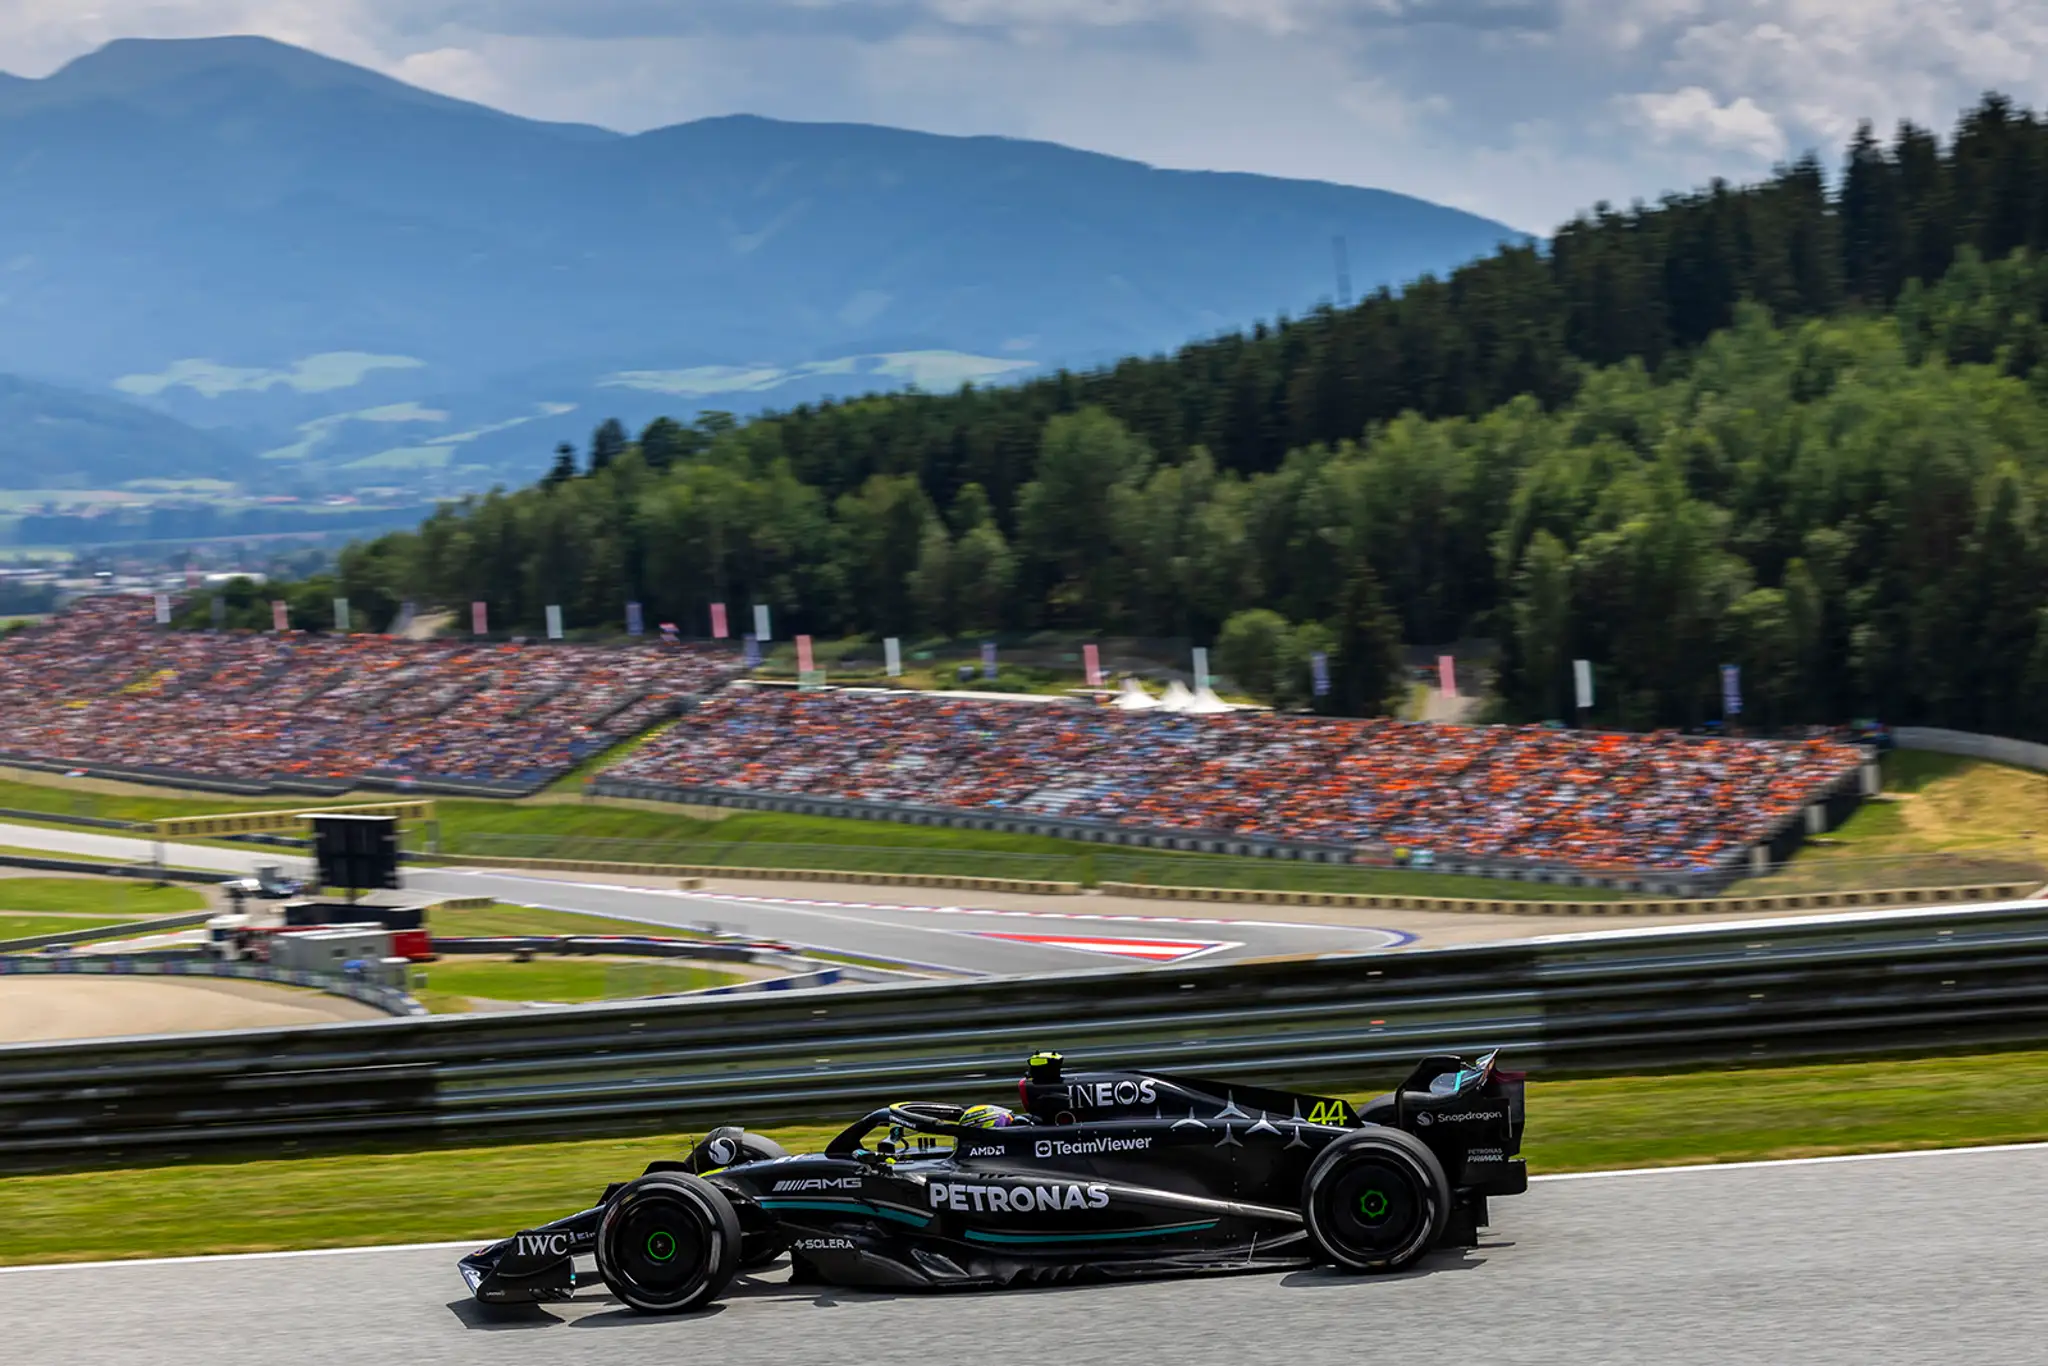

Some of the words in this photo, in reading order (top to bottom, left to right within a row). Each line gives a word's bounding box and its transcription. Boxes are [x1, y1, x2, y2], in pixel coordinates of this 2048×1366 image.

[1067, 1080, 1156, 1109] INEOS
[1308, 1101, 1347, 1126] 44
[1438, 1111, 1502, 1122] Snapdragon
[970, 1146, 995, 1156] AMD
[1053, 1137, 1152, 1155] TeamViewer
[802, 1178, 862, 1190] AMG
[929, 1182, 1109, 1212] PETRONAS
[517, 1234, 567, 1256] IWC
[805, 1239, 854, 1249] SOLERA
